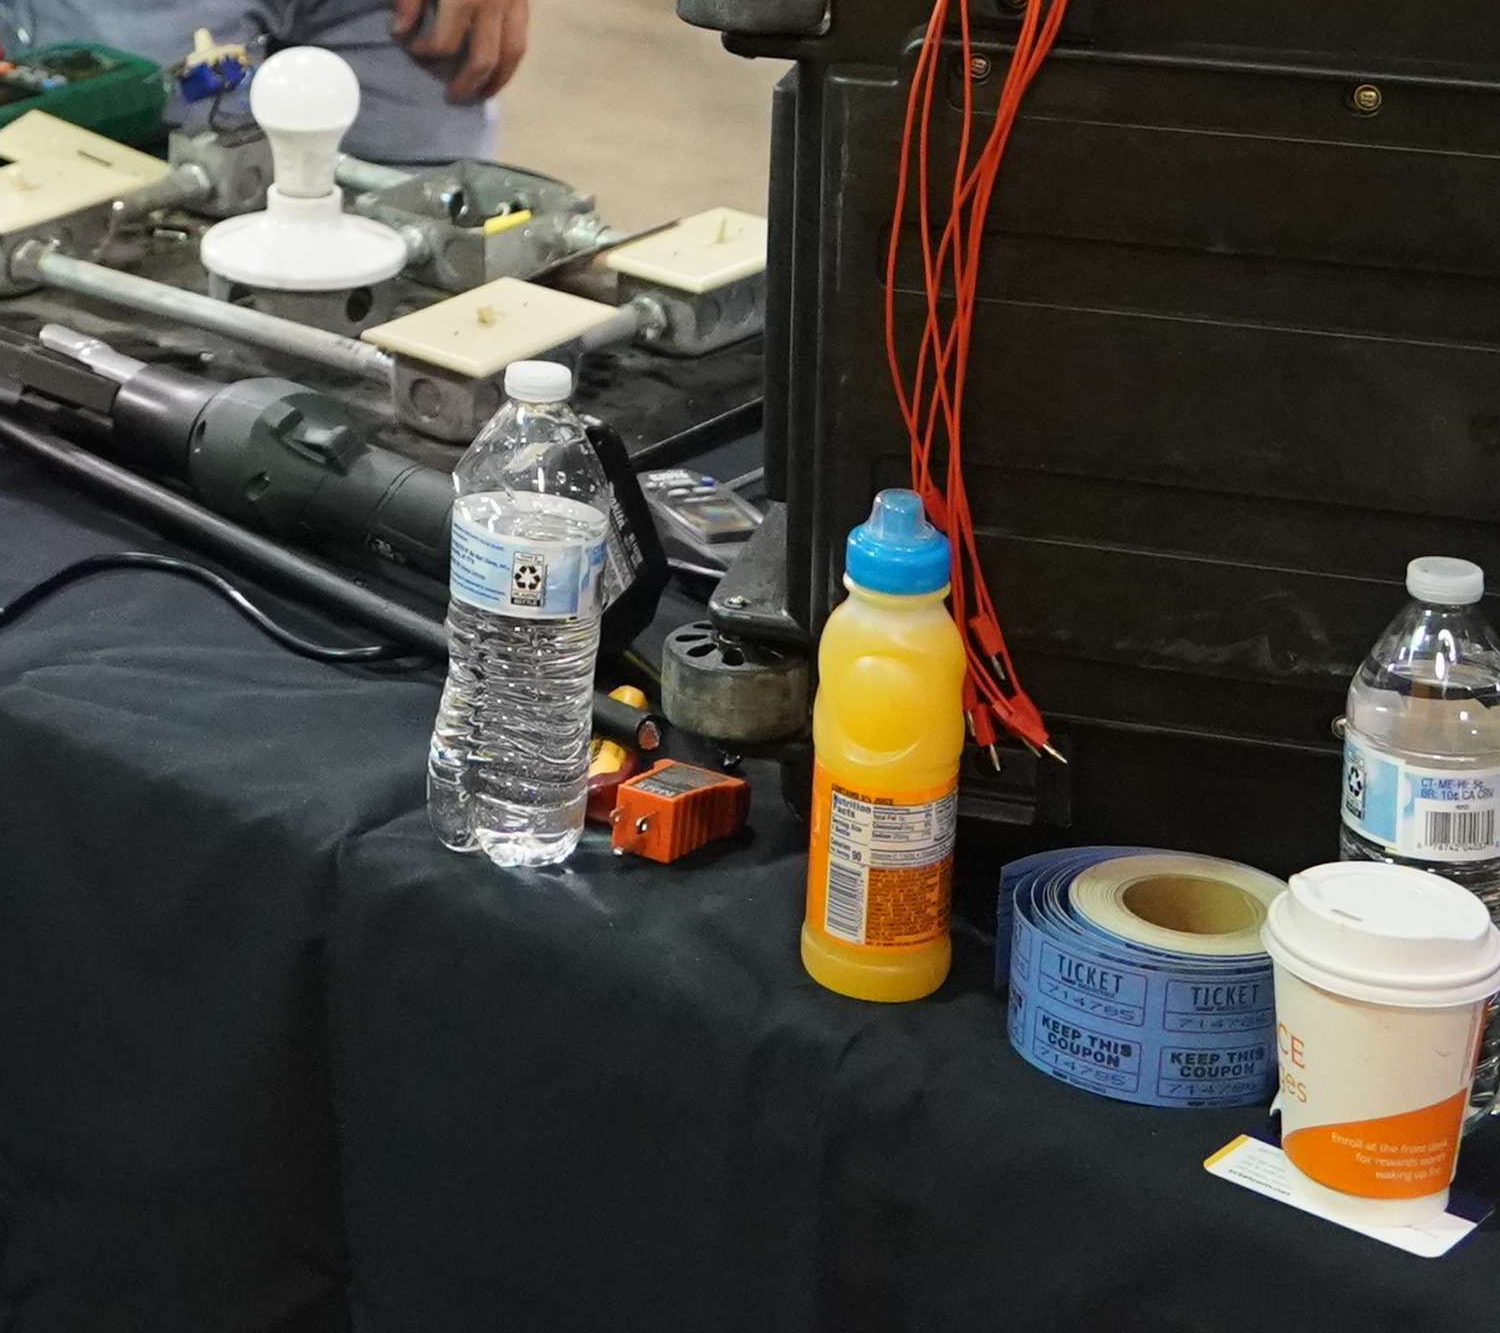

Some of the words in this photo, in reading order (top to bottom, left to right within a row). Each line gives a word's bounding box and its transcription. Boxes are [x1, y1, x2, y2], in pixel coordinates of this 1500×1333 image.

[1057, 953, 1124, 994] TICKET
[1190, 983, 1260, 1007] TICKET
[1041, 1013, 1083, 1042] KEEP
[1087, 1034, 1133, 1057] THIS
[1046, 1031, 1121, 1069] COUPON
[1170, 1050, 1221, 1066] KEEP
[1227, 1046, 1266, 1063] THIS
[1179, 1062, 1257, 1080] COUPON
[1331, 1131, 1364, 1151] Enroll
[1366, 1141, 1378, 1152] at
[1379, 1141, 1399, 1154] the
[1400, 1139, 1427, 1154] front
[1355, 1151, 1373, 1165] for
